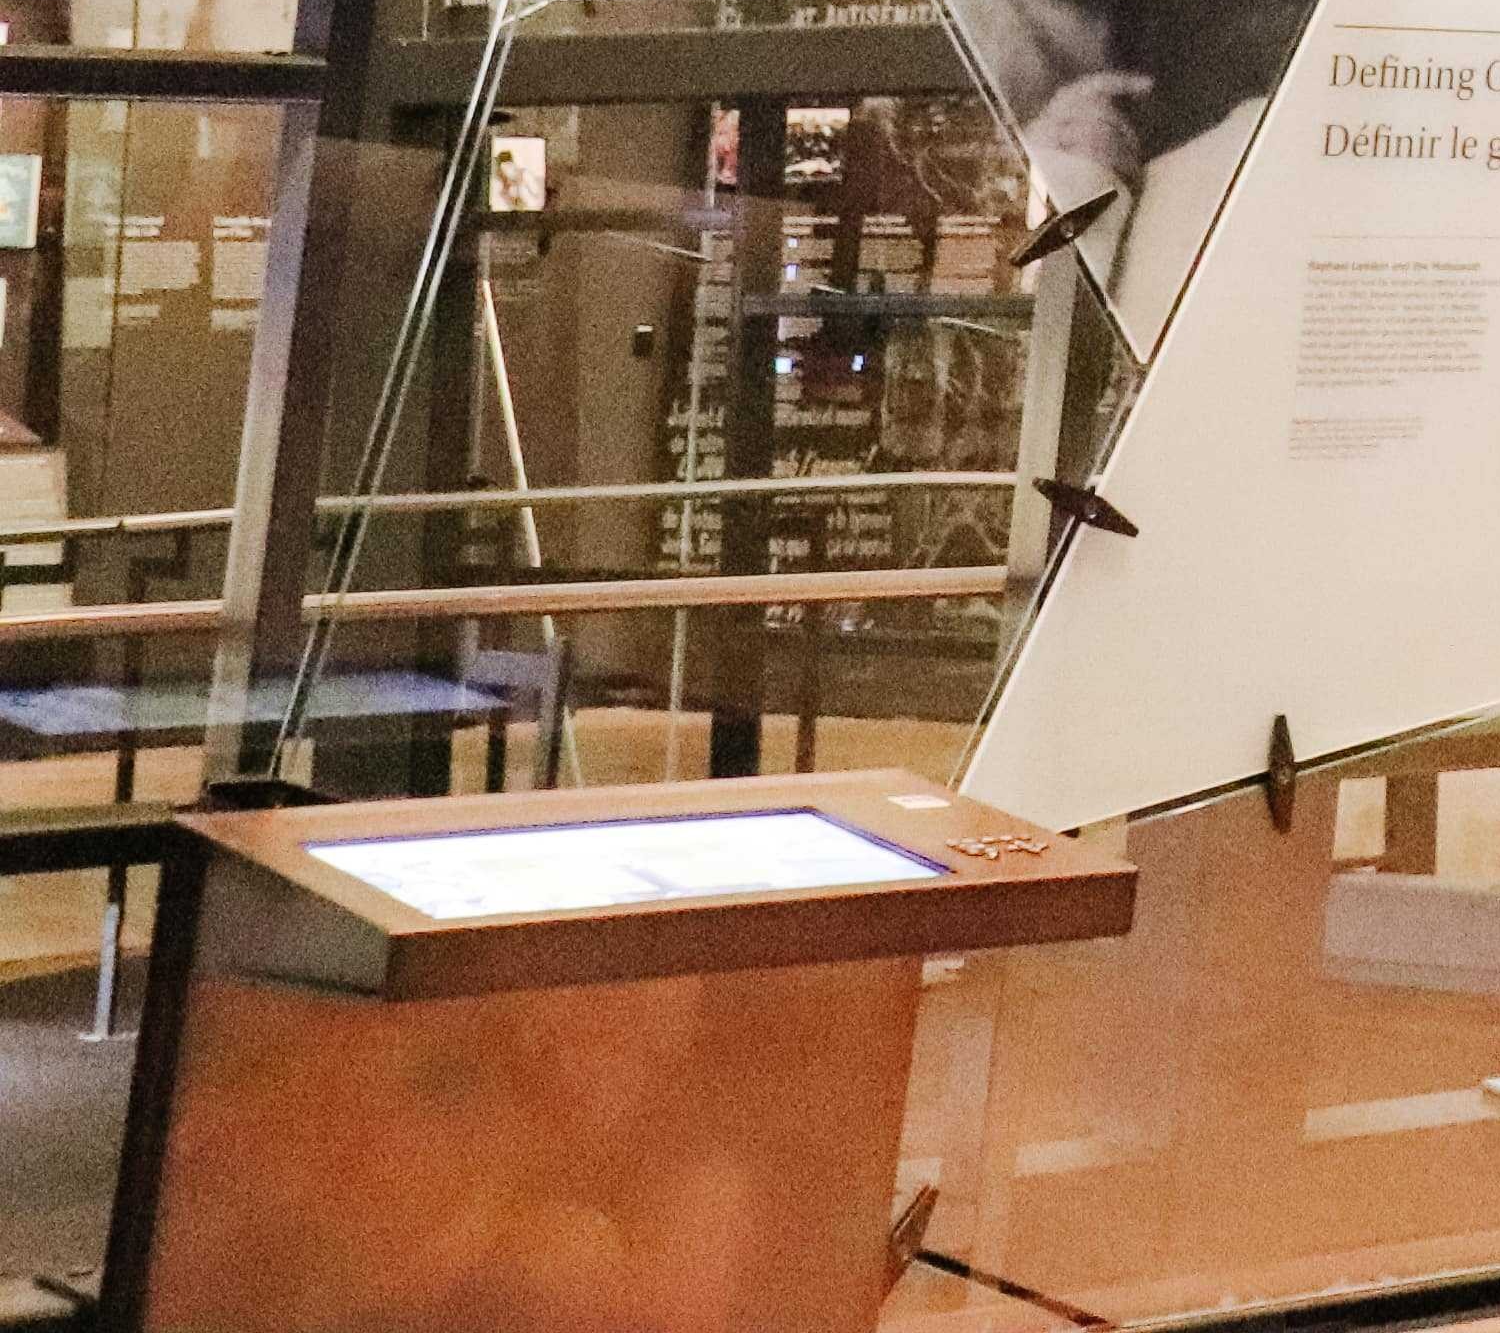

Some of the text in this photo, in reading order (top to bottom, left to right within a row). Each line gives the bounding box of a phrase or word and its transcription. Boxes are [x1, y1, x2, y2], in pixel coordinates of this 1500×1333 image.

[1330, 52, 1477, 101] Defining
[1322, 123, 1442, 159] Définir
[1450, 125, 1478, 160] le
